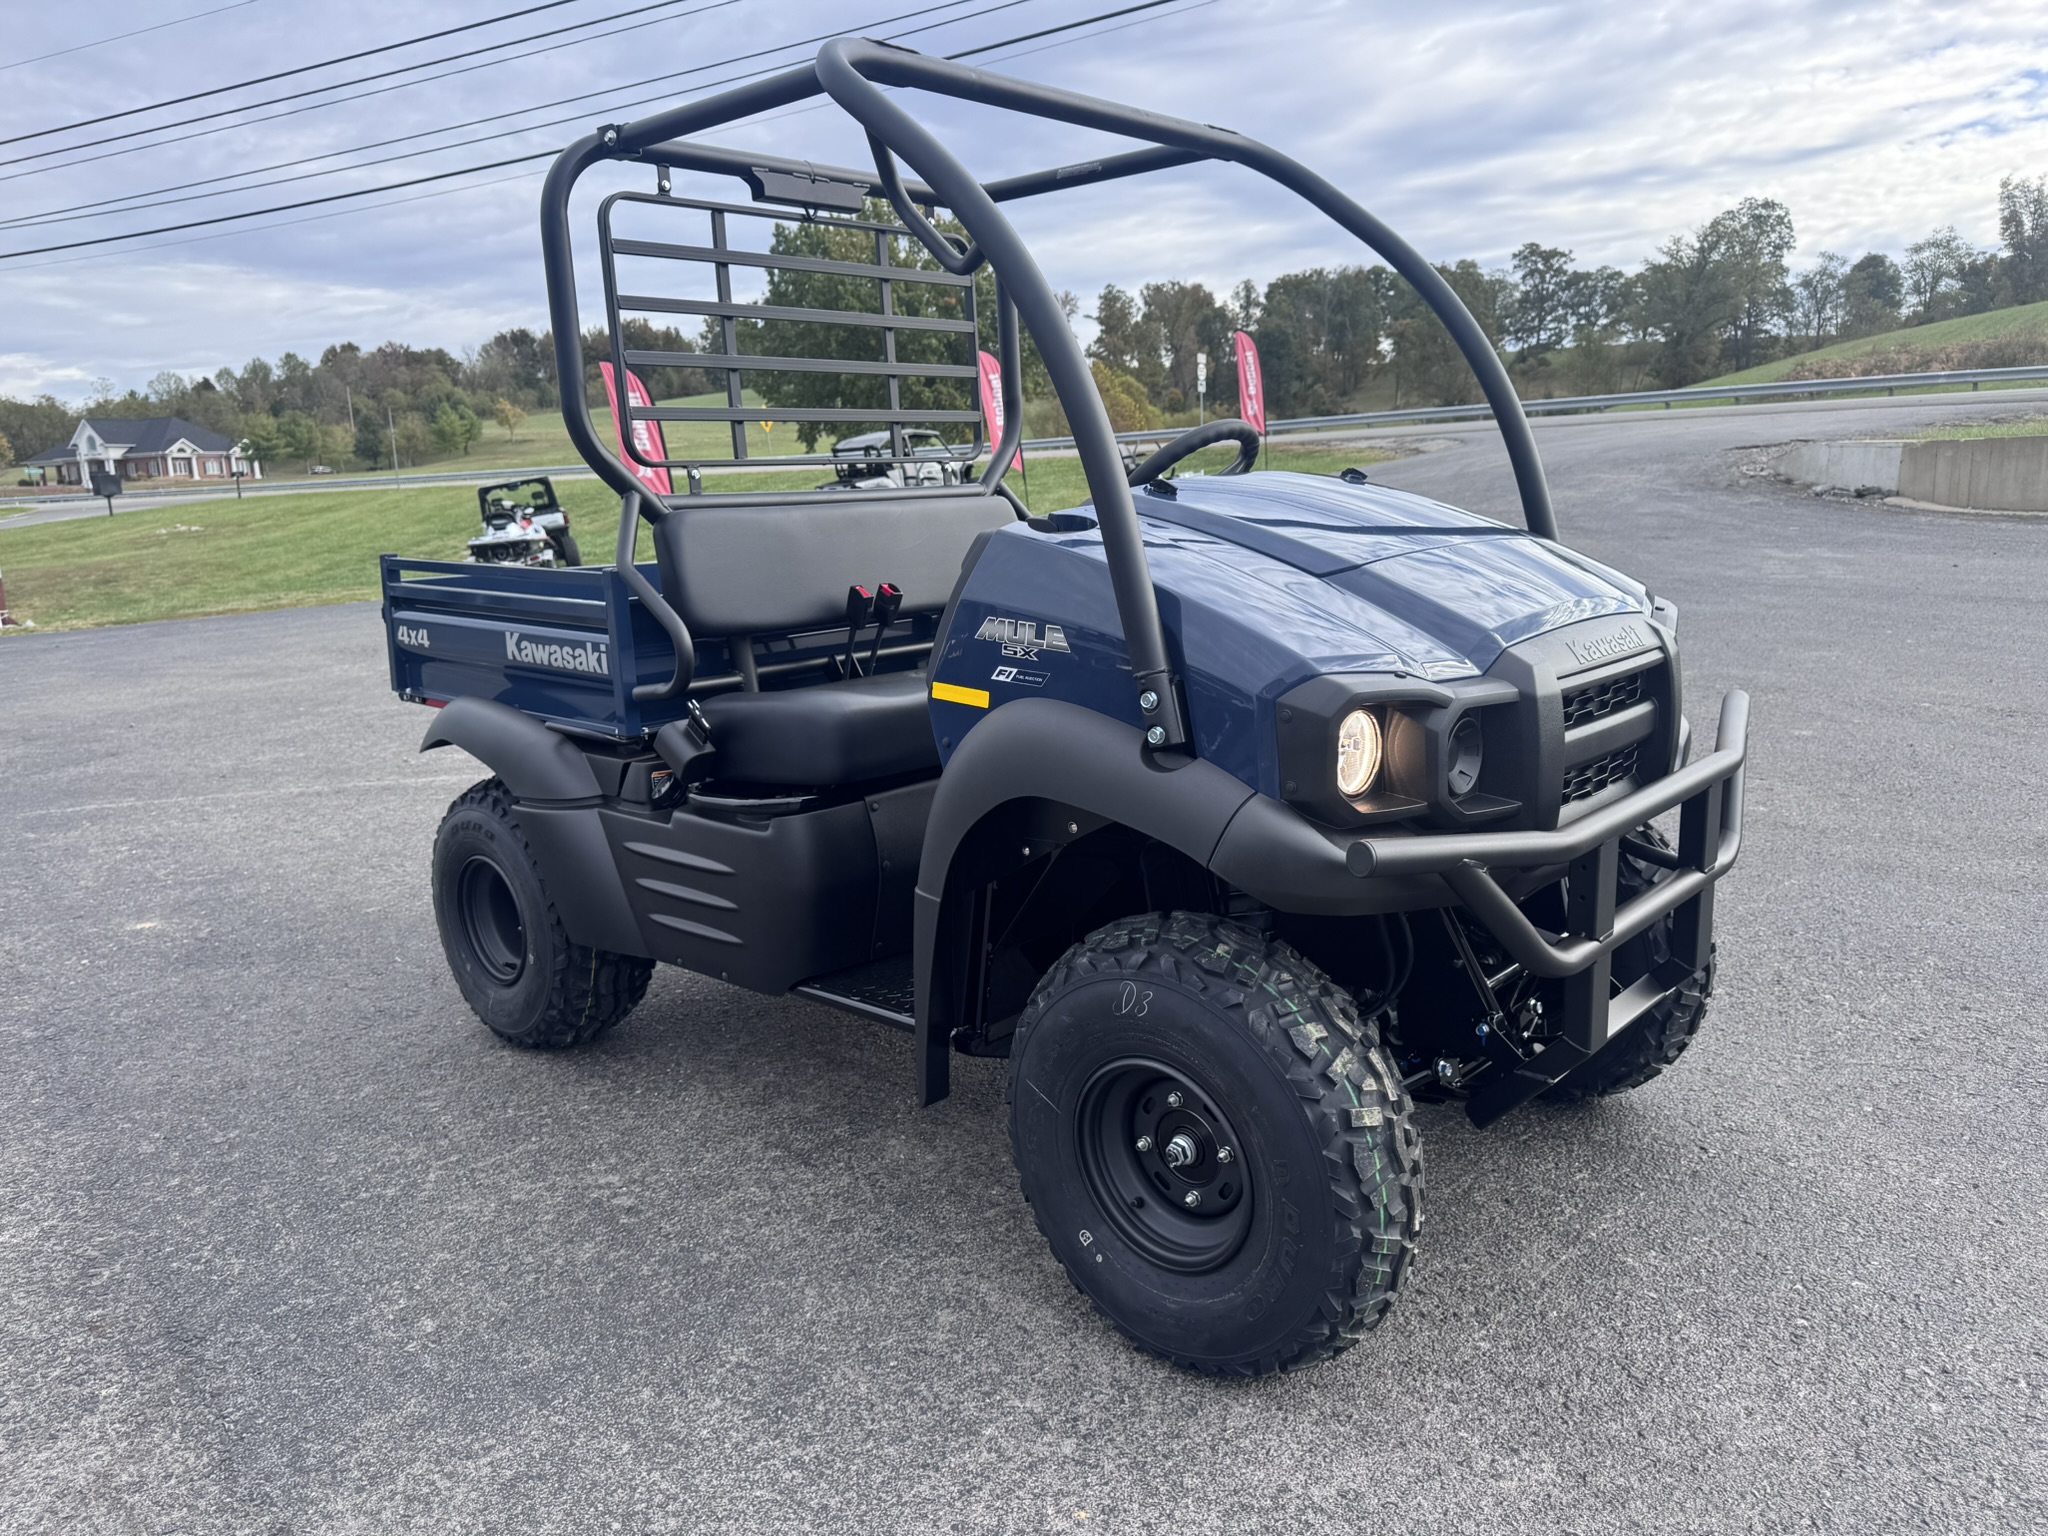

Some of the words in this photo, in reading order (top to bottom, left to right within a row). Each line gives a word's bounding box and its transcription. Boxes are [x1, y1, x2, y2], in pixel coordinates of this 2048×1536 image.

[397, 625, 430, 648] 4x4
[974, 616, 1071, 653] MULE
[1565, 625, 1646, 665] Kawasaki
[505, 631, 609, 674] Kawasaki
[1002, 643, 1039, 661] SX
[994, 668, 1014, 680] FI
